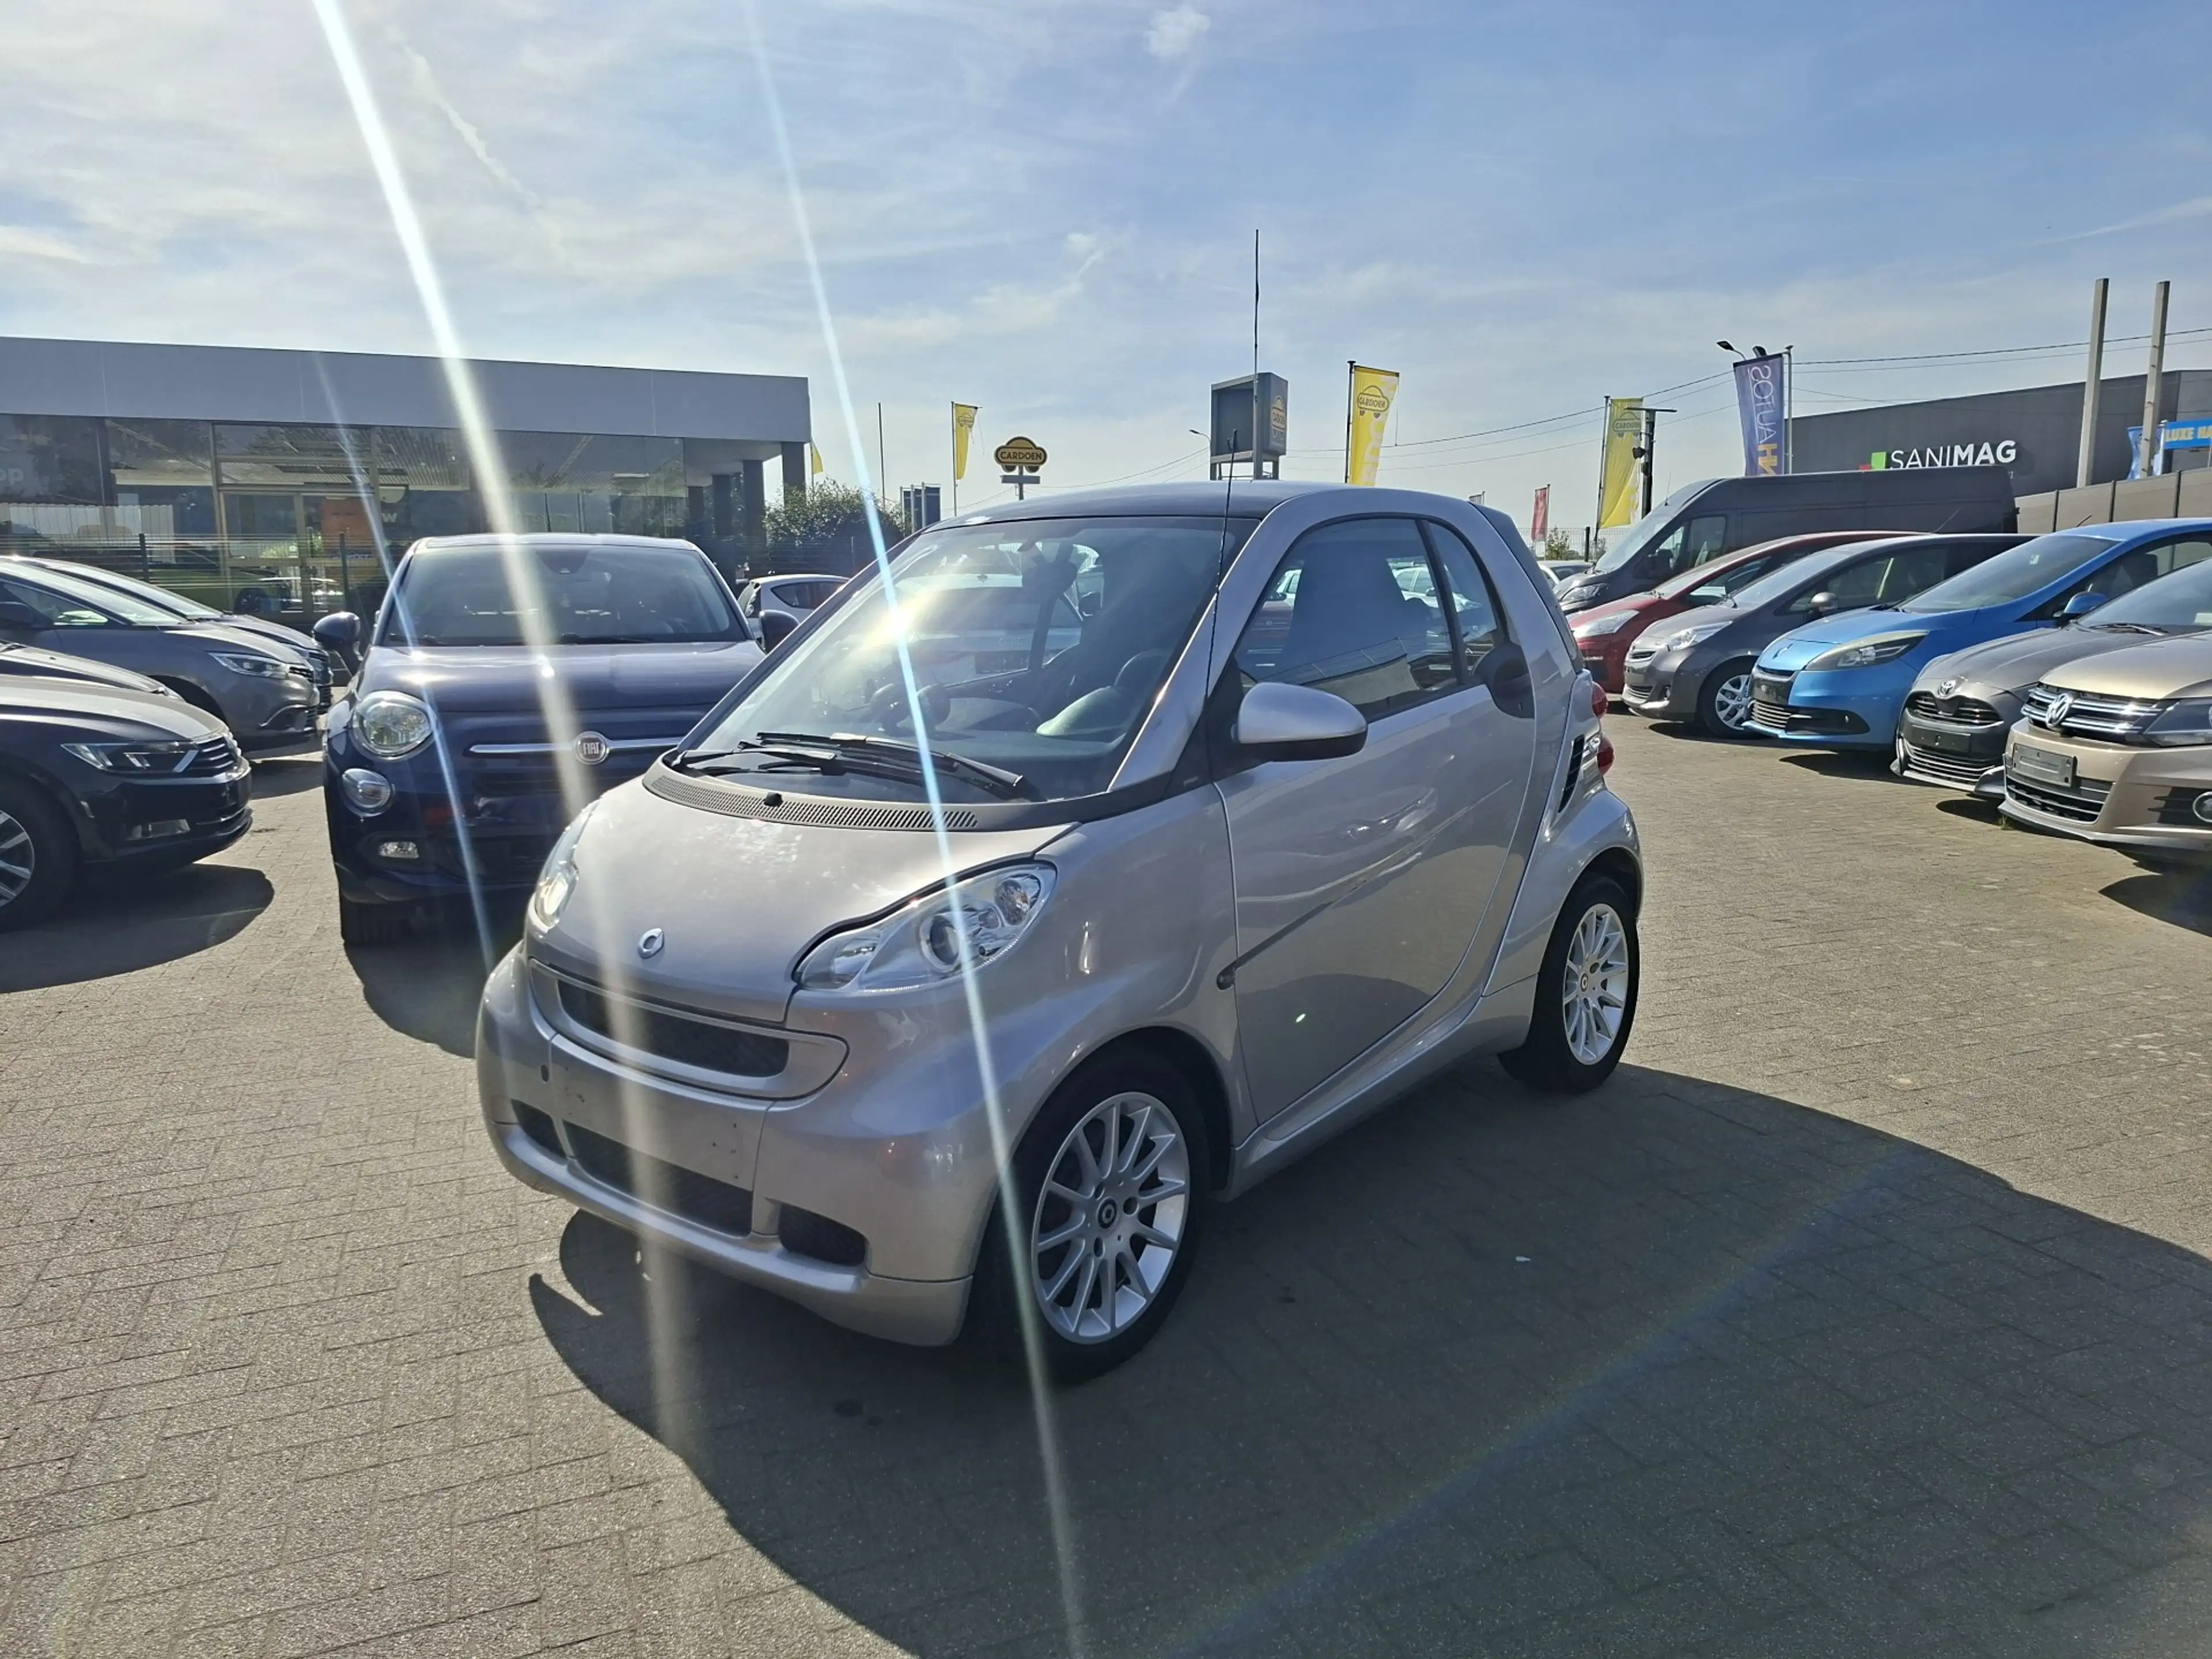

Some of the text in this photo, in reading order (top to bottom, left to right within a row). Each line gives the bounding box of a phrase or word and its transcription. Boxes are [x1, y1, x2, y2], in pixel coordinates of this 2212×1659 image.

[1000, 451, 1043, 460] CARDOEN
[1889, 439, 2017, 469] SANIMAG
[583, 742, 600, 755] FIAT
